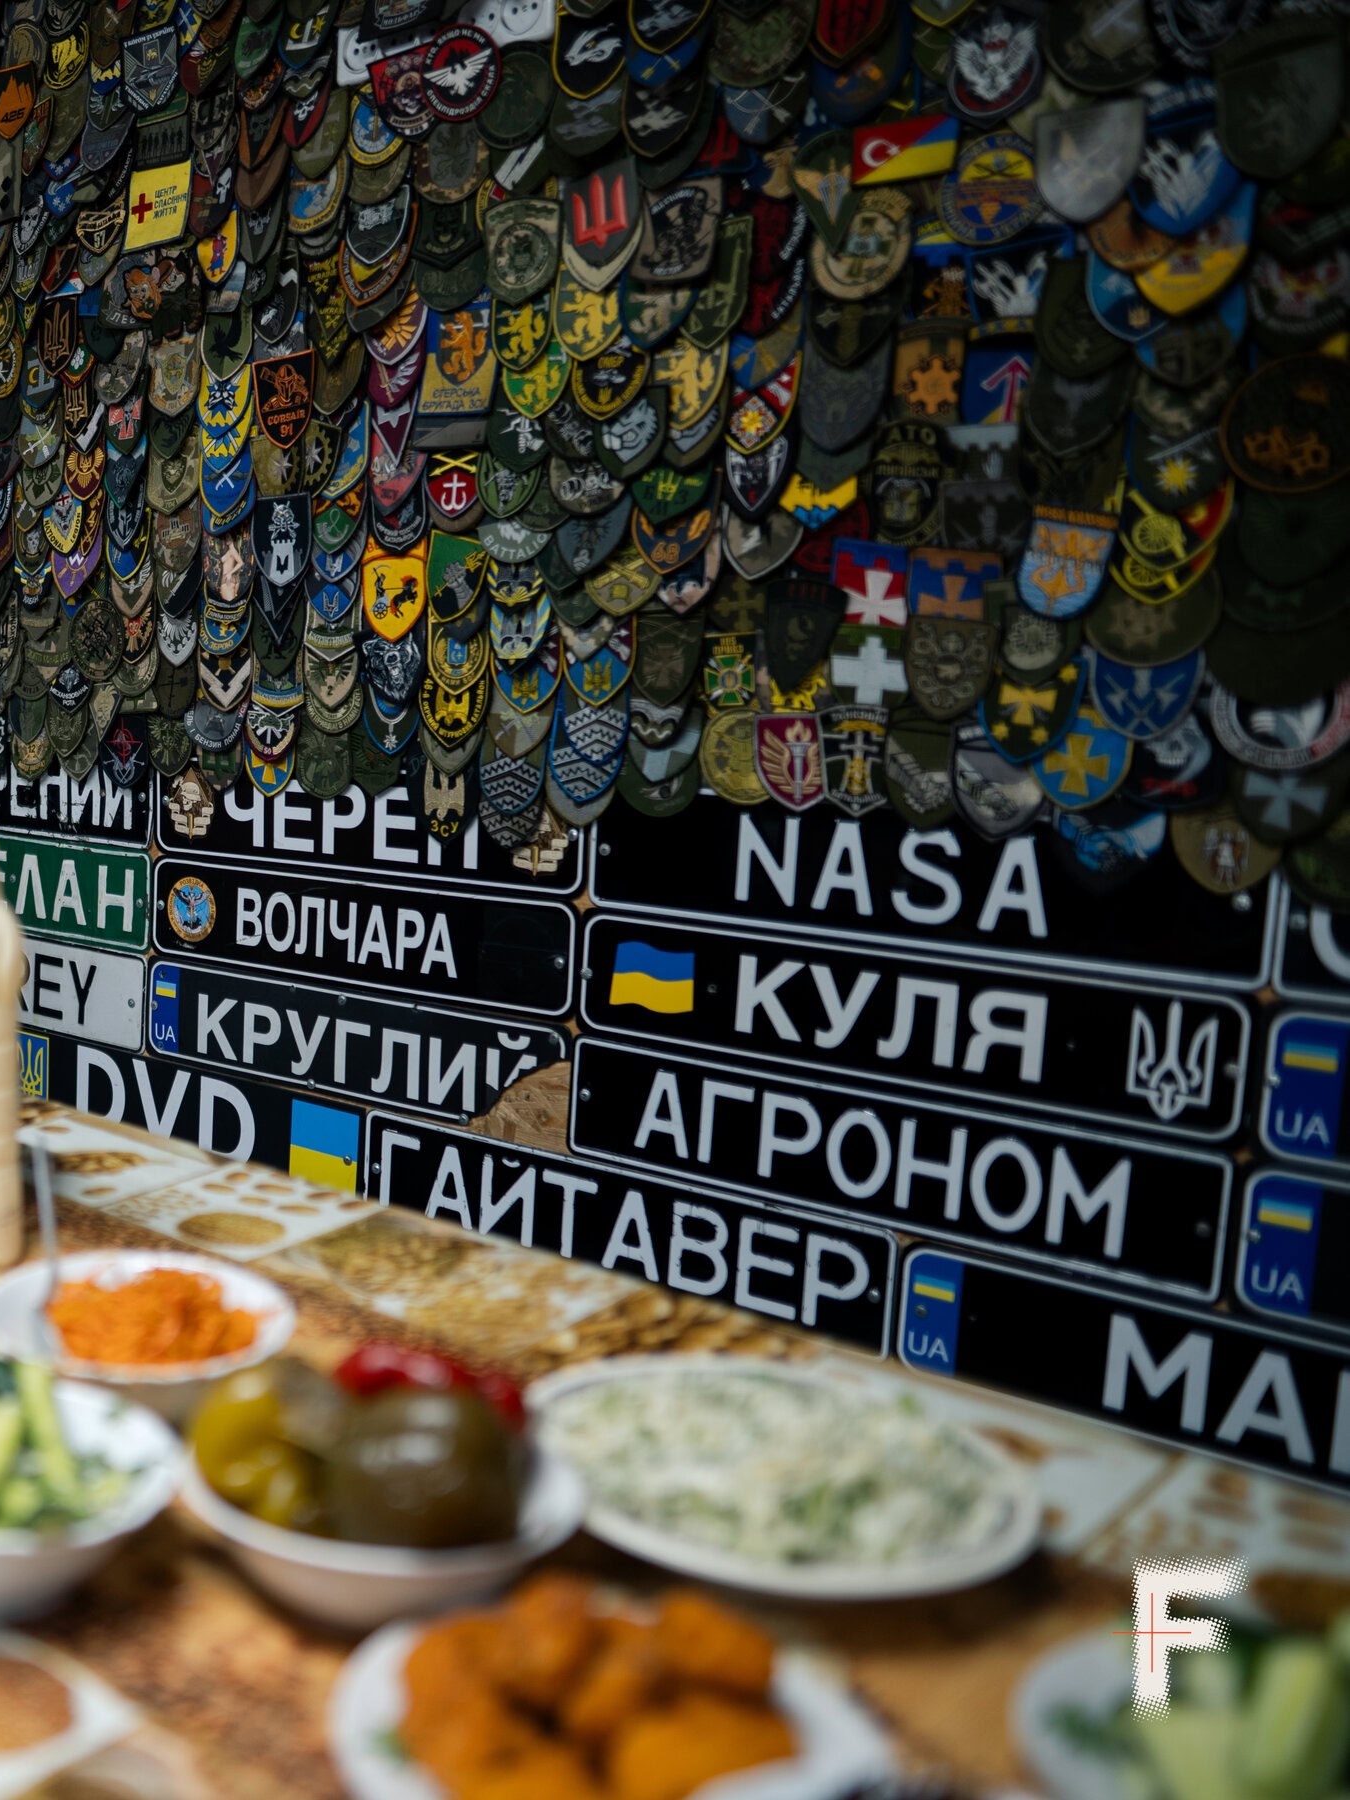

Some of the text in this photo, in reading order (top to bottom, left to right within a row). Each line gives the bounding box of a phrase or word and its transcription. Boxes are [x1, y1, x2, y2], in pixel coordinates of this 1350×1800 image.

[267, 408, 306, 426] CORSAIR
[44, 519, 64, 551] NATIONAL
[483, 532, 548, 560] BATTALIO
[650, 542, 681, 564] 68
[194, 733, 222, 749] БЕНЗИН
[223, 722, 242, 747] ПОНАД
[430, 819, 459, 838] ЗСУ
[735, 813, 1049, 939] NASA
[236, 887, 458, 979] ВОЛЧАРА
[154, 1022, 177, 1044] UA
[734, 954, 1049, 1084] КУЛЯ
[75, 1043, 256, 1164] DVD
[1273, 1107, 1331, 1148] UA
[634, 1068, 1132, 1260] АГРОНОМ
[379, 1128, 871, 1327] ГАЙТАВЕР
[1250, 1262, 1306, 1303] UA
[906, 1330, 950, 1364] UA
